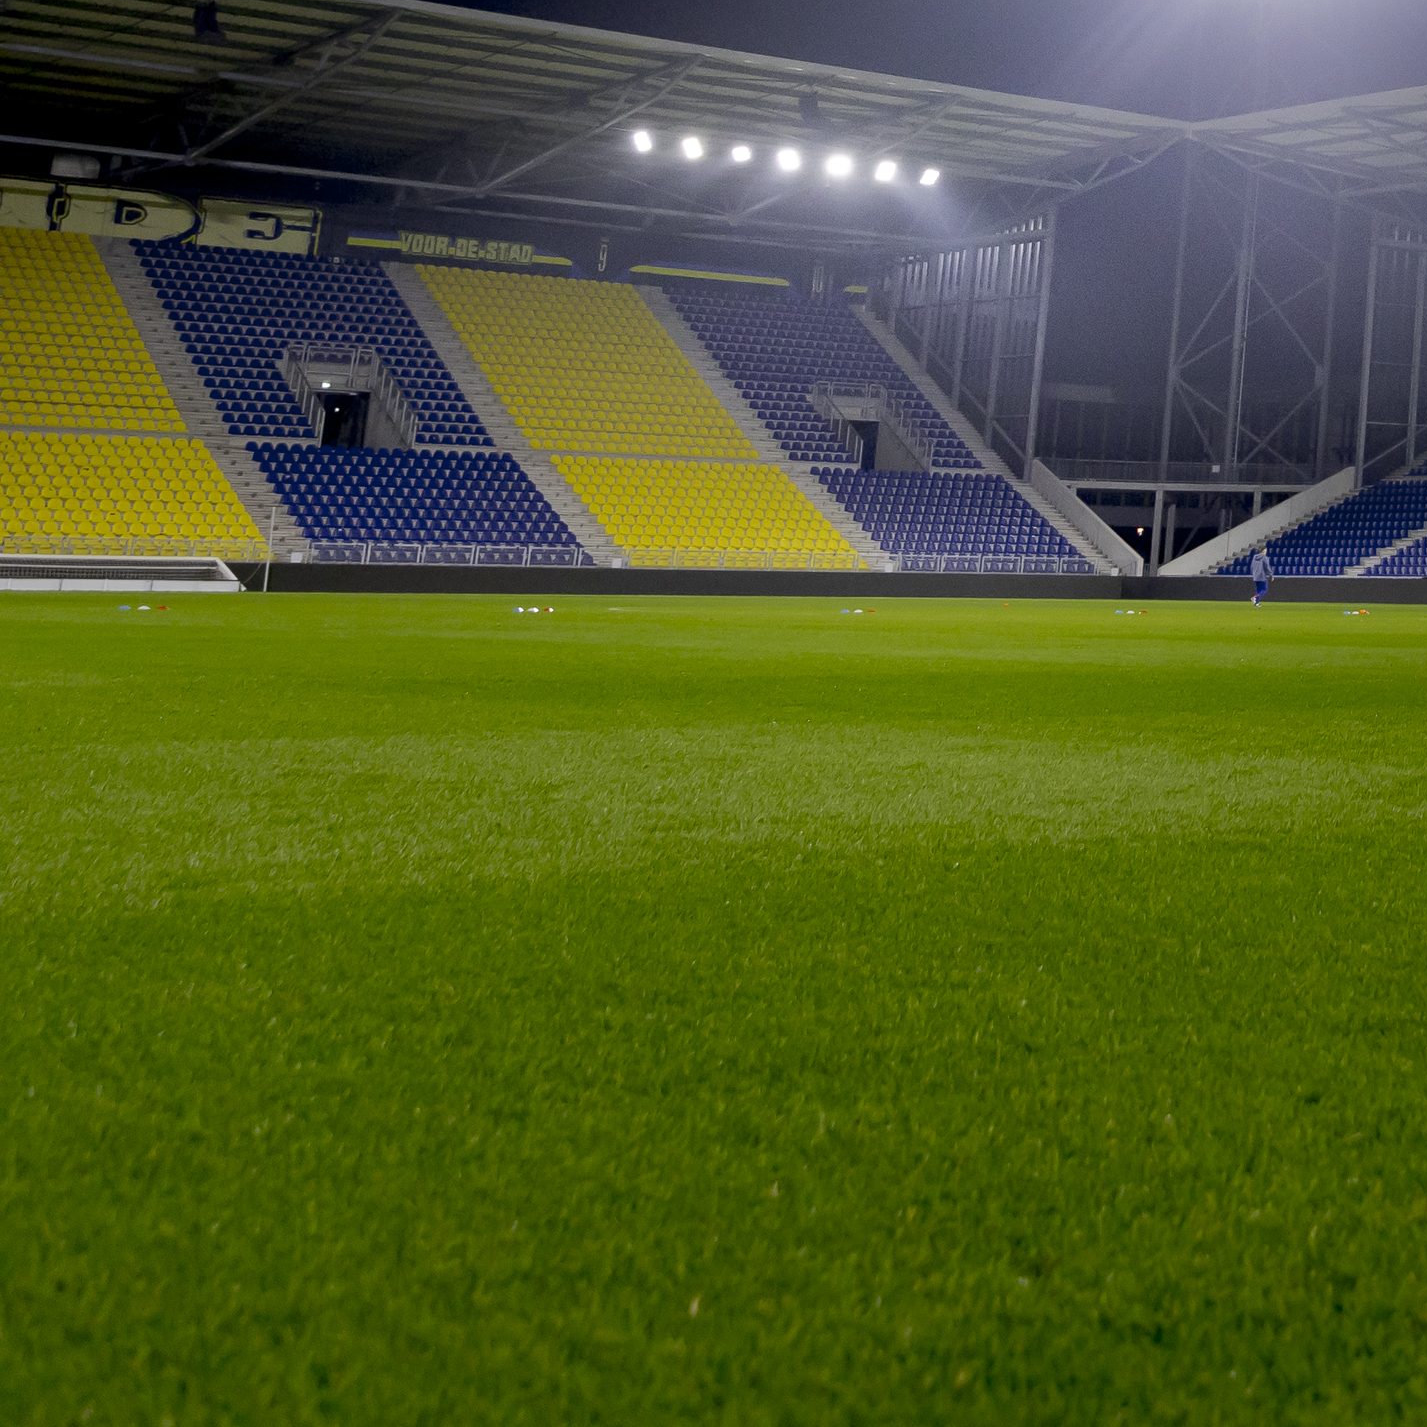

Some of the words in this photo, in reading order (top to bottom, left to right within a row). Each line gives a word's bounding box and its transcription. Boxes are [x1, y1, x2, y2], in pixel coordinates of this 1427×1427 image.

[400, 230, 450, 256] VOOR
[453, 236, 479, 260] DE
[484, 239, 534, 264] STAD
